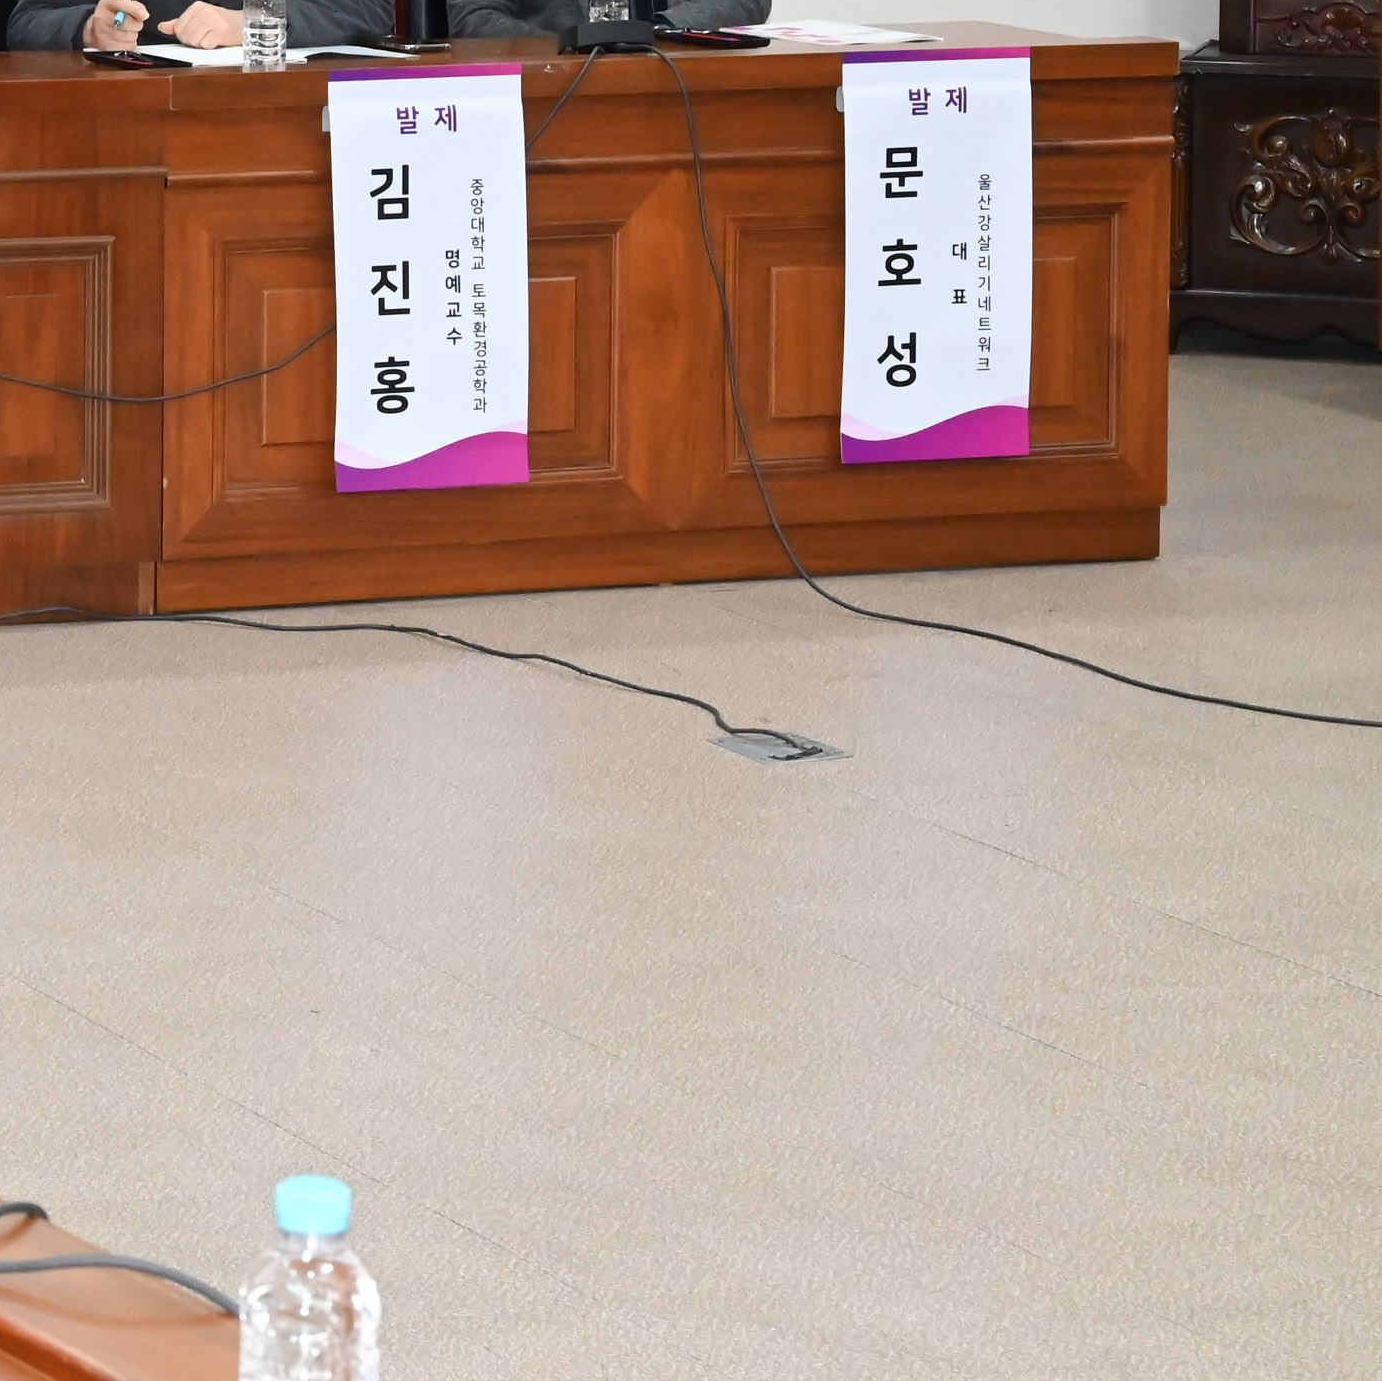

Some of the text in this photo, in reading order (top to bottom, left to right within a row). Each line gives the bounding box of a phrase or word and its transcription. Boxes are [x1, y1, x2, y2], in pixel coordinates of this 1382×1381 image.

[397, 105, 456, 134] 발제
[909, 87, 967, 115] 발제
[370, 165, 415, 414] 김진홍
[446, 249, 462, 345] 명예교수
[471, 179, 487, 413] 중앙대학교 토목환경공학과
[877, 147, 923, 387] 문호성
[977, 174, 991, 371] 울산강살리기네트워크
